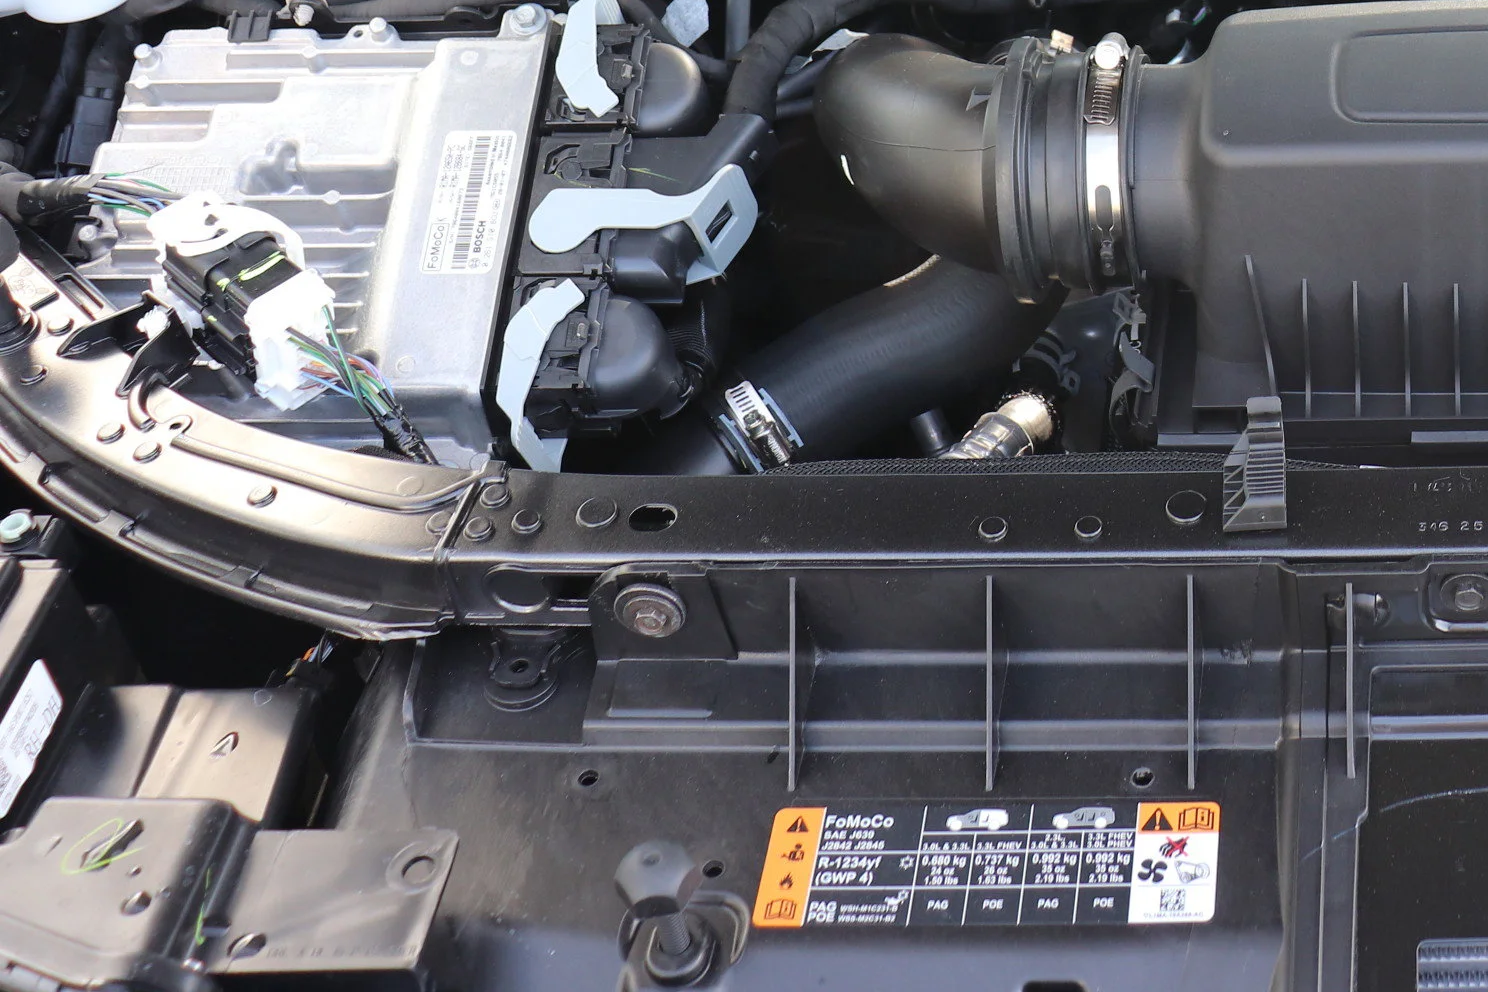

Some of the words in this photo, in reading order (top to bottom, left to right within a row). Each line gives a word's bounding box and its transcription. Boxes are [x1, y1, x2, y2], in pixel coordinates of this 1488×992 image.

[473, 220, 486, 253] BOSCH
[428, 226, 444, 268] FoMoCo
[824, 813, 894, 829] FoMoCo
[824, 830, 847, 839] SAE
[849, 830, 874, 839] J639
[1088, 832, 1106, 840] 3.3L
[1108, 832, 1134, 840] FHEV
[821, 840, 851, 850] J2842
[854, 840, 885, 850] J2845
[942, 842, 950, 850] &
[952, 842, 970, 850] 3.3L
[977, 842, 995, 850] 3.3L
[996, 842, 1022, 850] FHEV
[1031, 841, 1048, 849] 3.0L
[1051, 841, 1058, 849] &
[1060, 841, 1078, 849] 3.3L
[1087, 840, 1105, 848] 3.0L
[1107, 840, 1133, 848] PHEV
[818, 856, 882, 871] R-1234yf
[922, 854, 949, 866] 0.680
[952, 855, 967, 867] kg
[975, 854, 1003, 866] 0.737
[1006, 854, 1019, 867] kg
[1032, 853, 1061, 864] 0.992
[1063, 853, 1077, 866] kg
[1086, 853, 1114, 864] 0.992
[1117, 853, 1131, 865] kg
[931, 866, 941, 875] 24
[1042, 865, 1052, 873] 35
[1095, 865, 1106, 873] 35
[814, 872, 856, 886] (GWP
[858, 872, 873, 886] 4)
[944, 876, 958, 885] lbs
[978, 876, 996, 885] 1.63
[998, 875, 1012, 885] lbs
[1035, 875, 1054, 884] 2.19
[1056, 874, 1070, 883] lbs
[1089, 874, 1107, 883] 2.19
[1109, 874, 1123, 882] lbs
[810, 901, 837, 912] PAG
[927, 900, 949, 910] PAG
[983, 899, 1004, 910] POE
[1037, 898, 1060, 909] PAG
[1093, 897, 1114, 908] POE
[806, 911, 836, 923] POE
